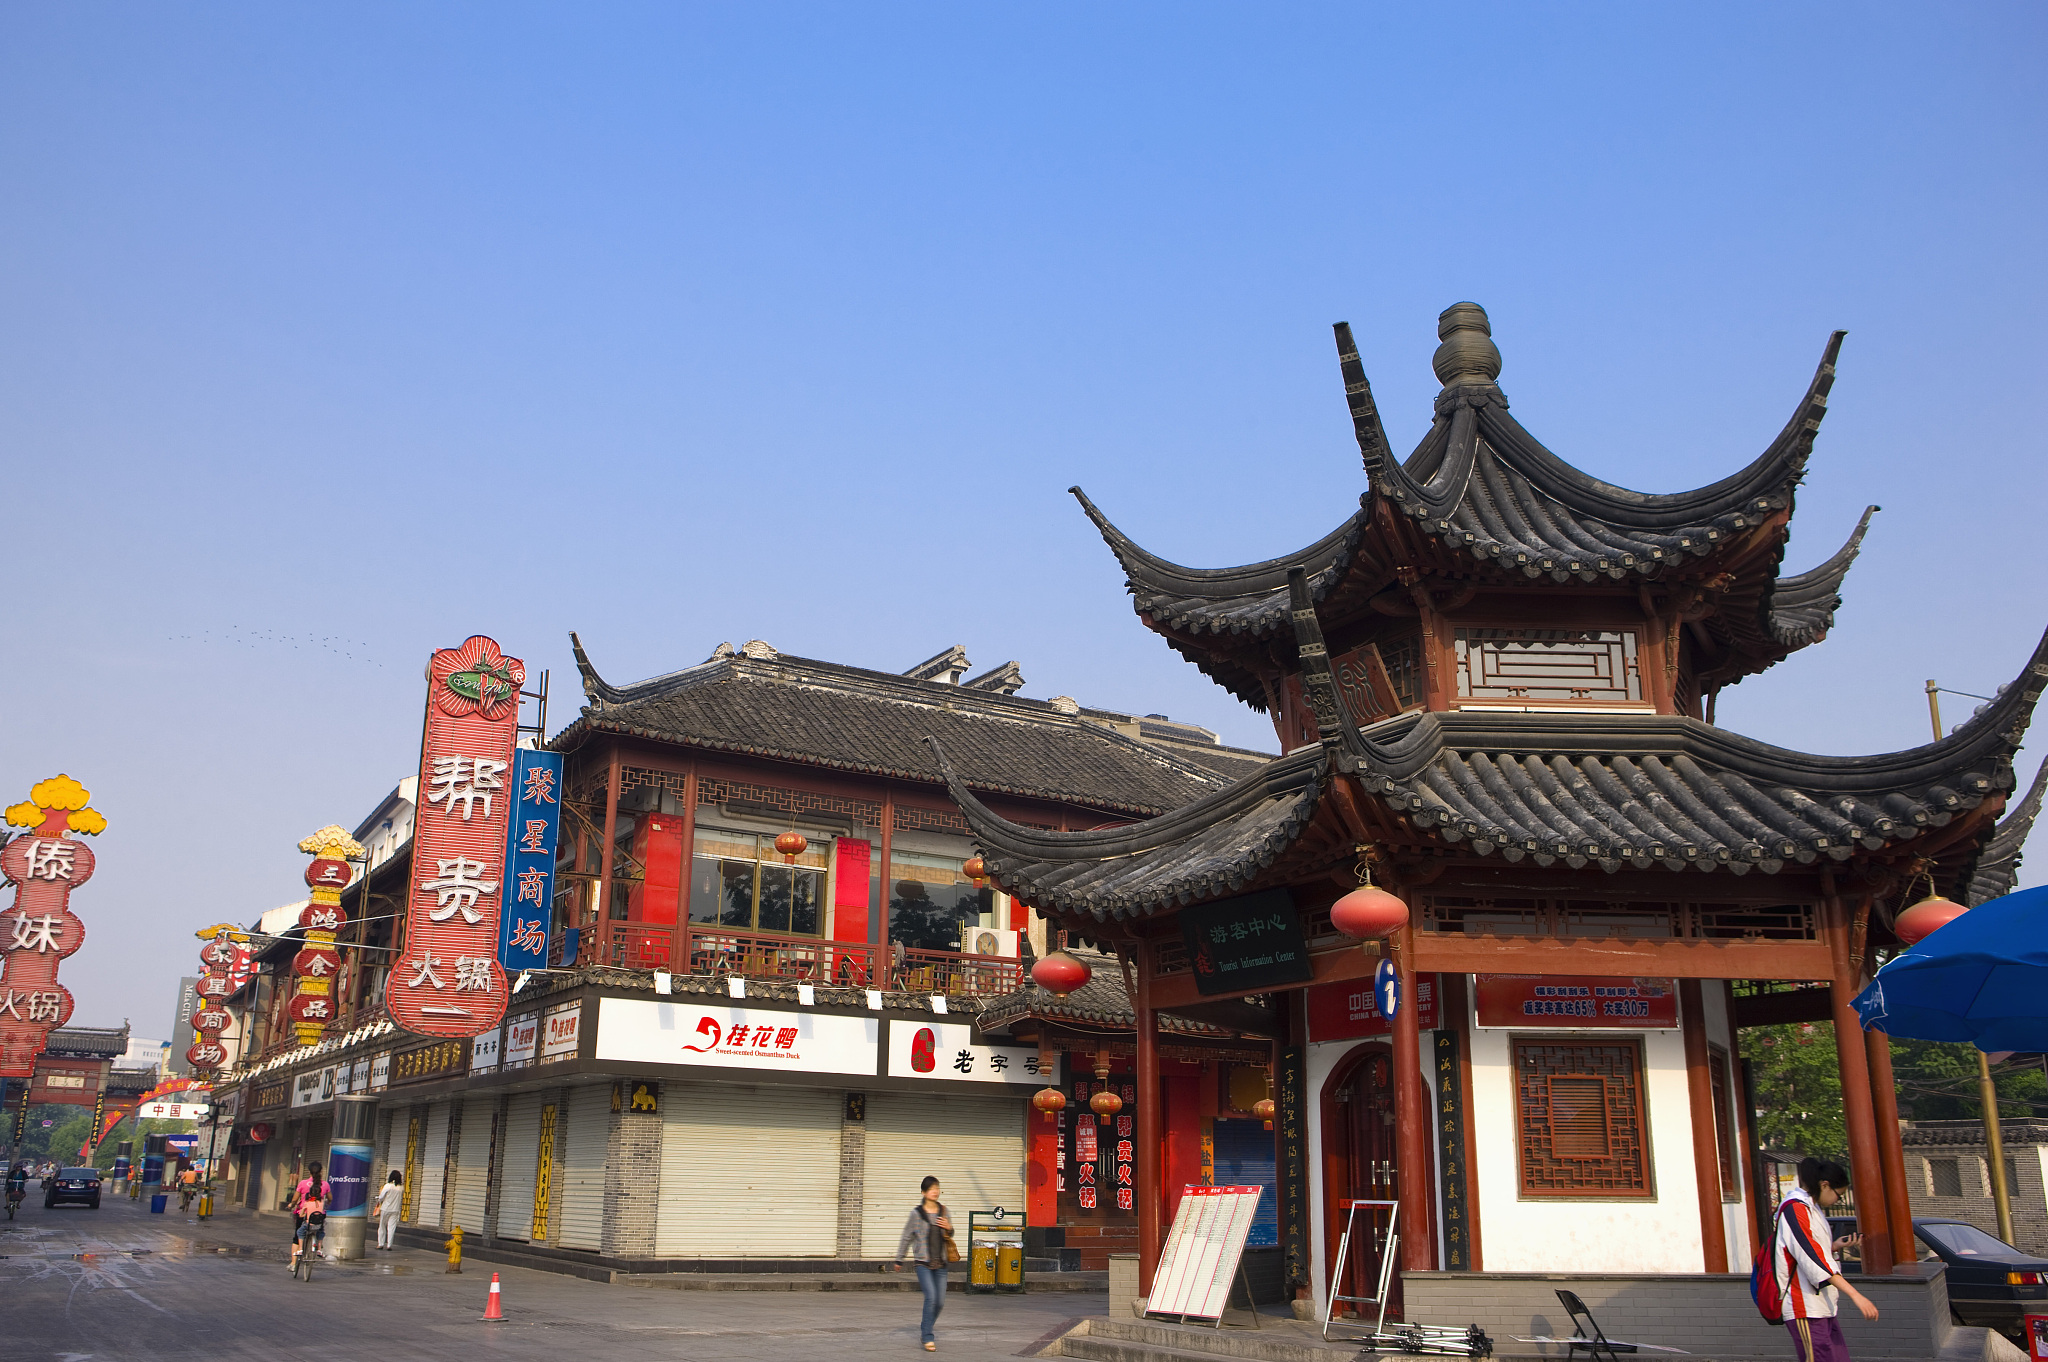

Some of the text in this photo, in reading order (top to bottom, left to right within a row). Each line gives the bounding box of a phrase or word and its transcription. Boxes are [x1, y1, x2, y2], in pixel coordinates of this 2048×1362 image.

[421, 754, 508, 924] 帮贵
[510, 767, 557, 956] 聚星商场
[8, 839, 76, 953] 傣妹
[1209, 913, 1287, 943] 游客中心
[407, 950, 493, 993] 火锅
[1219, 951, 1295, 972] Tourist Information Center
[1535, 986, 1638, 997] 福彩刮刮乐 即刮即兑
[0, 988, 61, 1022] 火锅
[1349, 1012, 1369, 1021] CHINA
[1523, 1000, 1649, 1017] 返奖率高达65% 大奖30万
[518, 1026, 535, 1045] 桂花鸭
[557, 1016, 577, 1038] 桂花鸭
[726, 1024, 798, 1049] 桂花鸭
[715, 1047, 801, 1060] Sweet-scented Osmanthus Duck
[953, 1049, 1041, 1075] 老字号
[153, 1103, 181, 1118] 中国
[1116, 1115, 1133, 1210] 帮贵火锅
[329, 1175, 360, 1184] DynaScan
